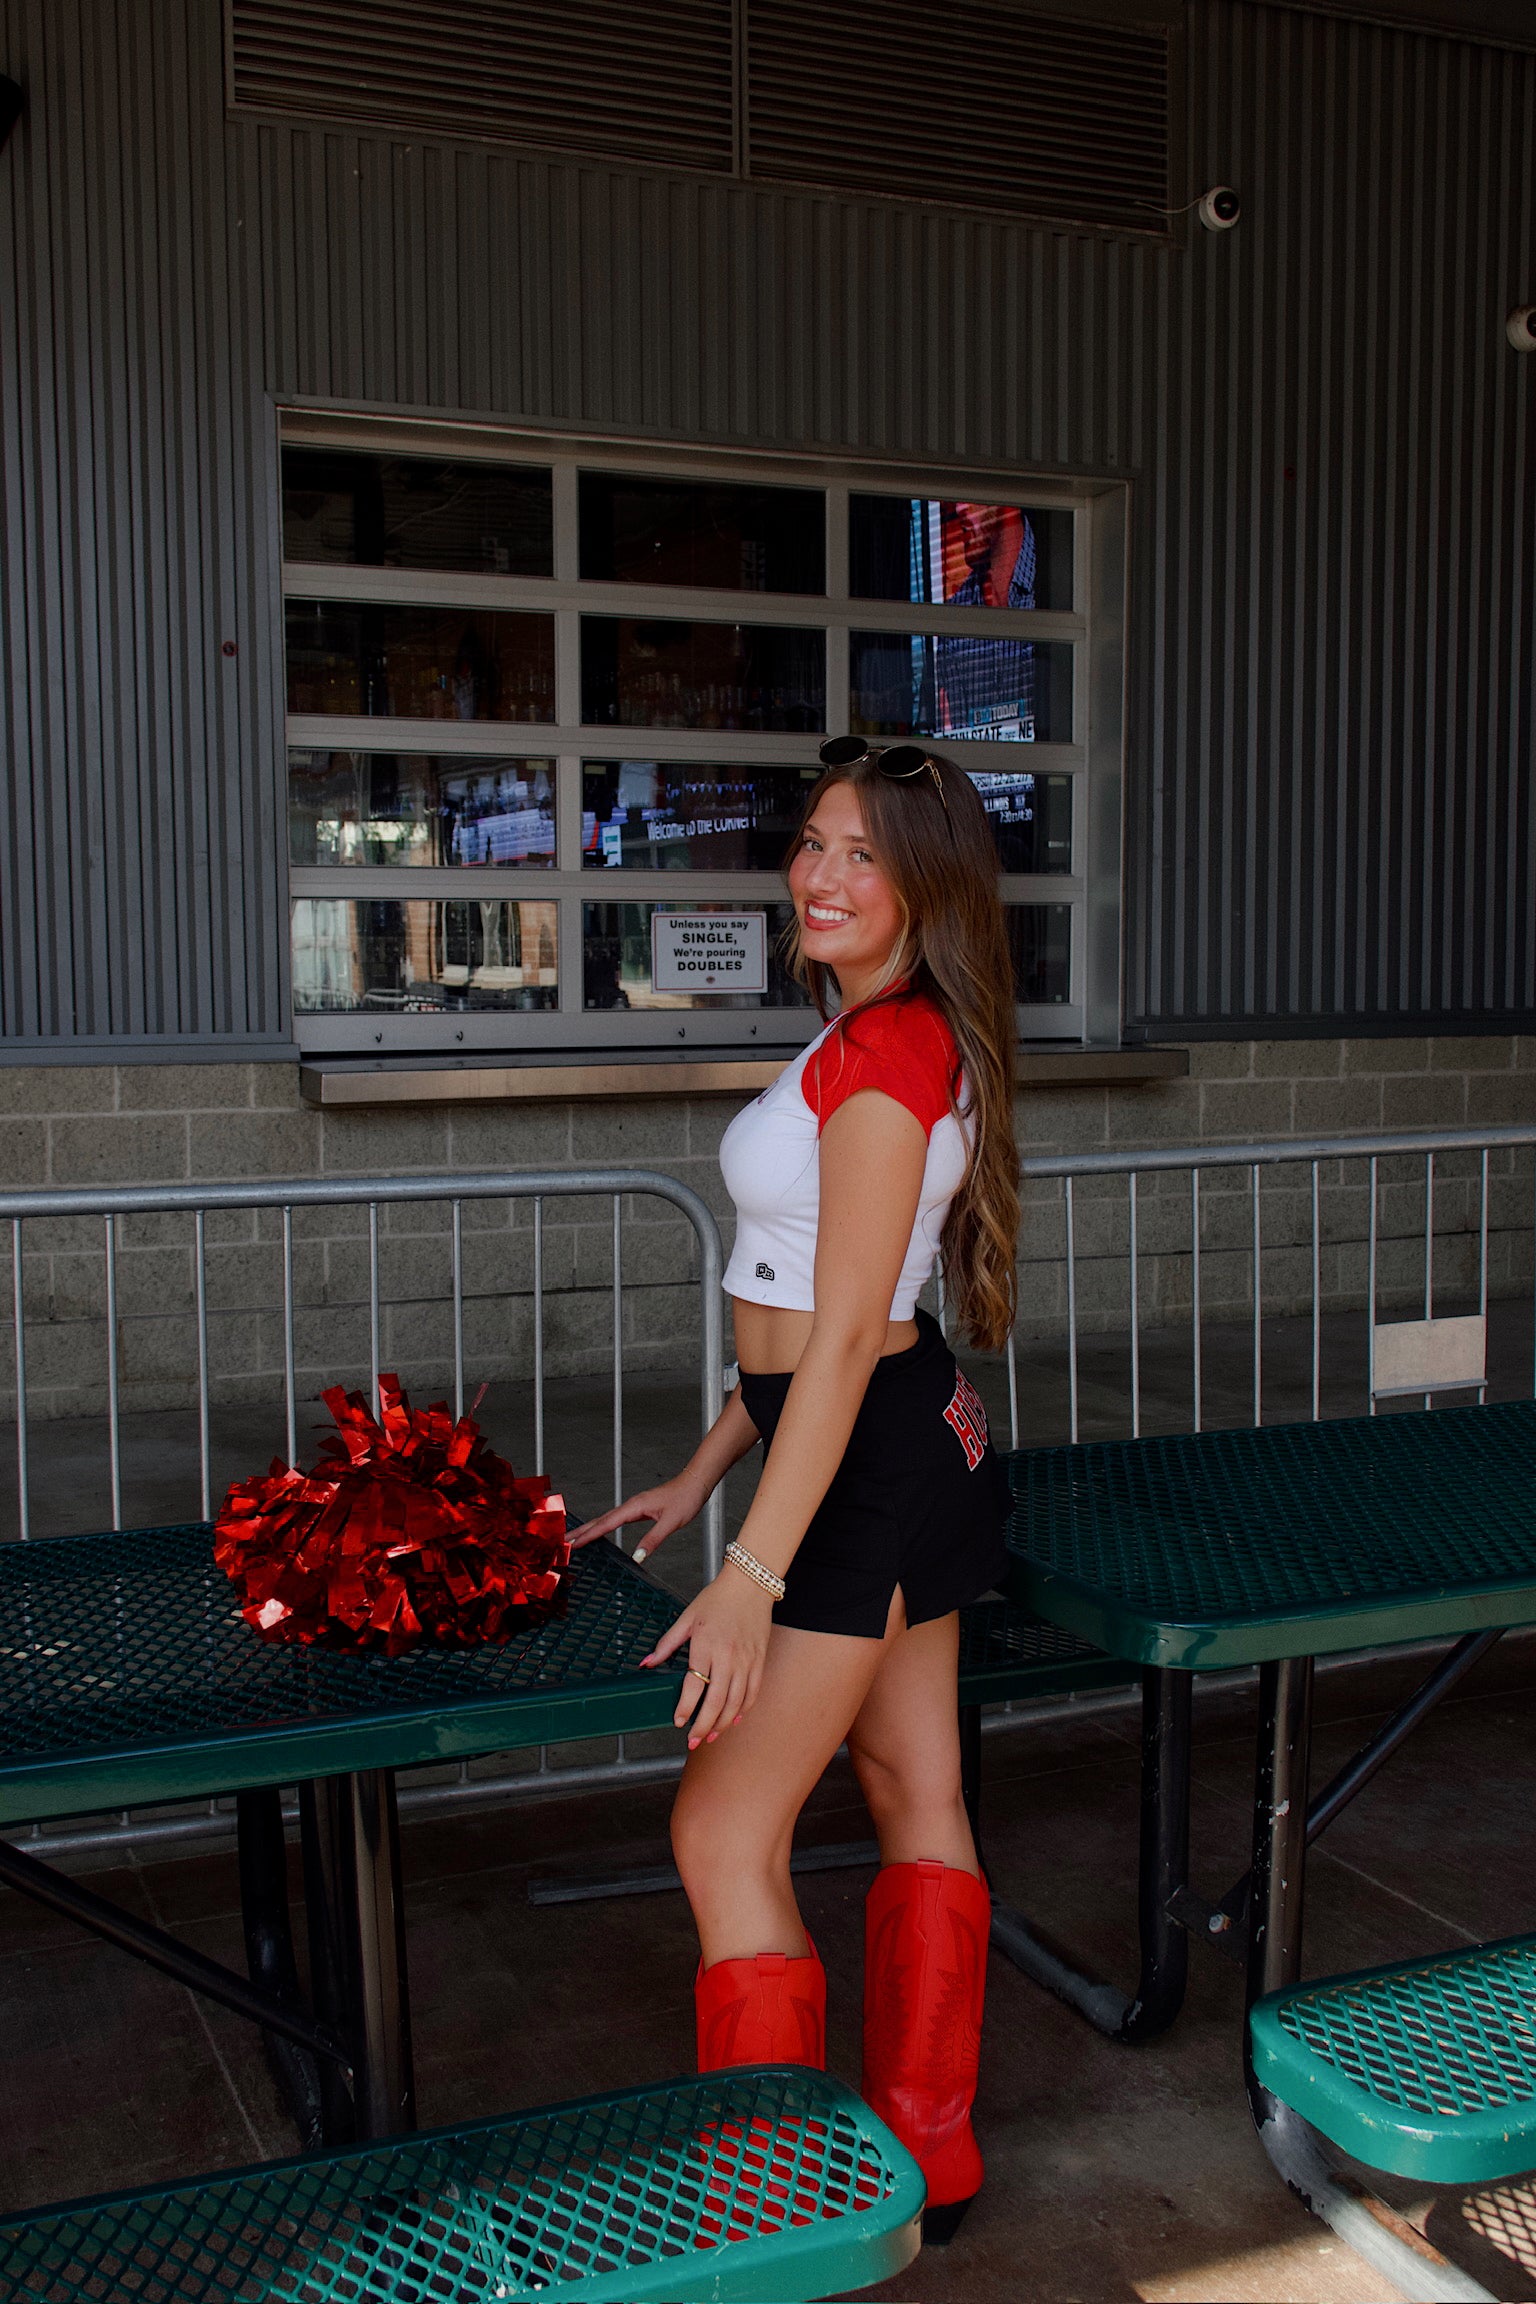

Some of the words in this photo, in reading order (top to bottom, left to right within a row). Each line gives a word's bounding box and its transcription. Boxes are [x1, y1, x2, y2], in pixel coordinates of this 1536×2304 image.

[992, 702, 1019, 721] TODAY
[647, 822, 685, 842] Welcome
[669, 920, 706, 929] Unless
[709, 921, 728, 930] you
[731, 920, 749, 930] say
[682, 933, 738, 945] SINGLE,
[673, 948, 704, 957] We're
[706, 948, 746, 959] pouring
[677, 961, 743, 971] DOUBLES
